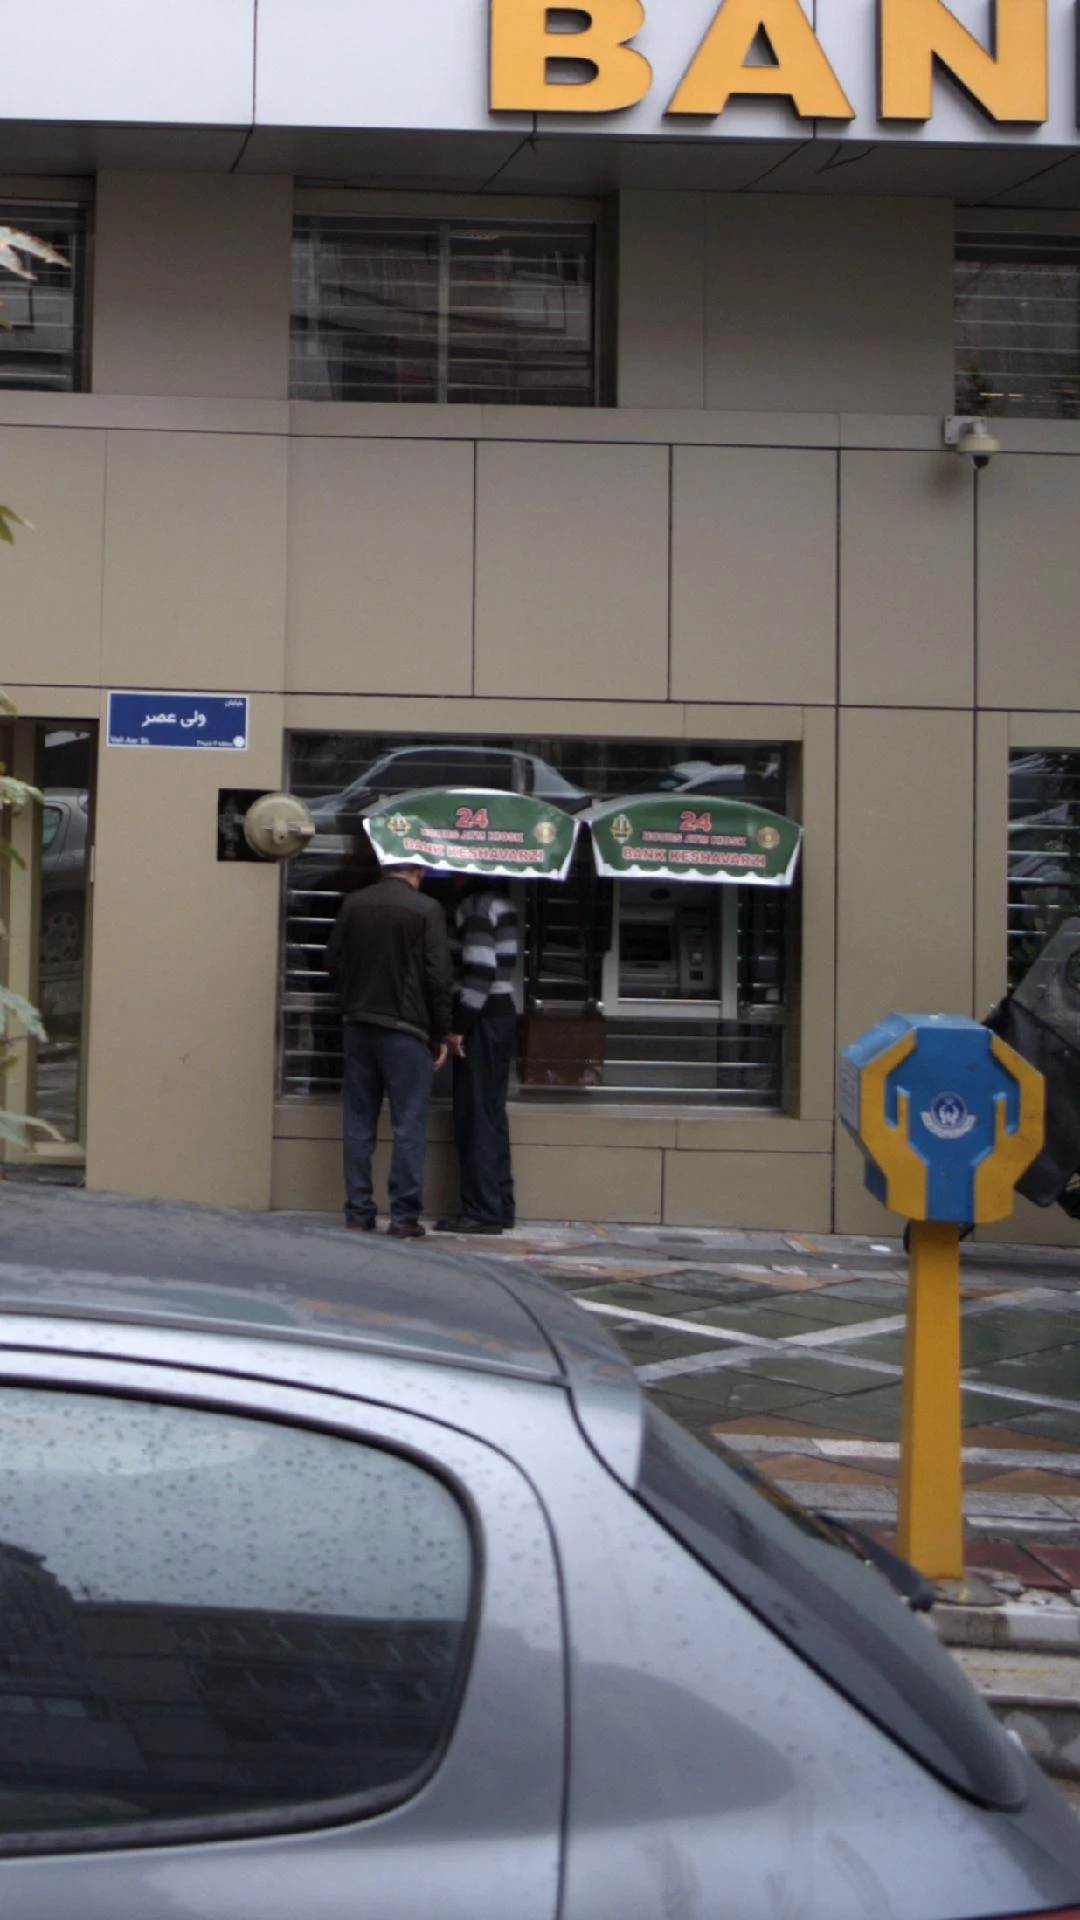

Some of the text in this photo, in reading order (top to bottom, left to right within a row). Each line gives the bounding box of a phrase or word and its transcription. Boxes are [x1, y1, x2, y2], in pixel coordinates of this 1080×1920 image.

[489, 0, 1080, 124] BAN
[141, 710, 207, 728] ولی عصر
[455, 807, 489, 829] 24
[679, 810, 712, 832] 24
[403, 837, 446, 857] BANK
[622, 846, 667, 862] BANK
